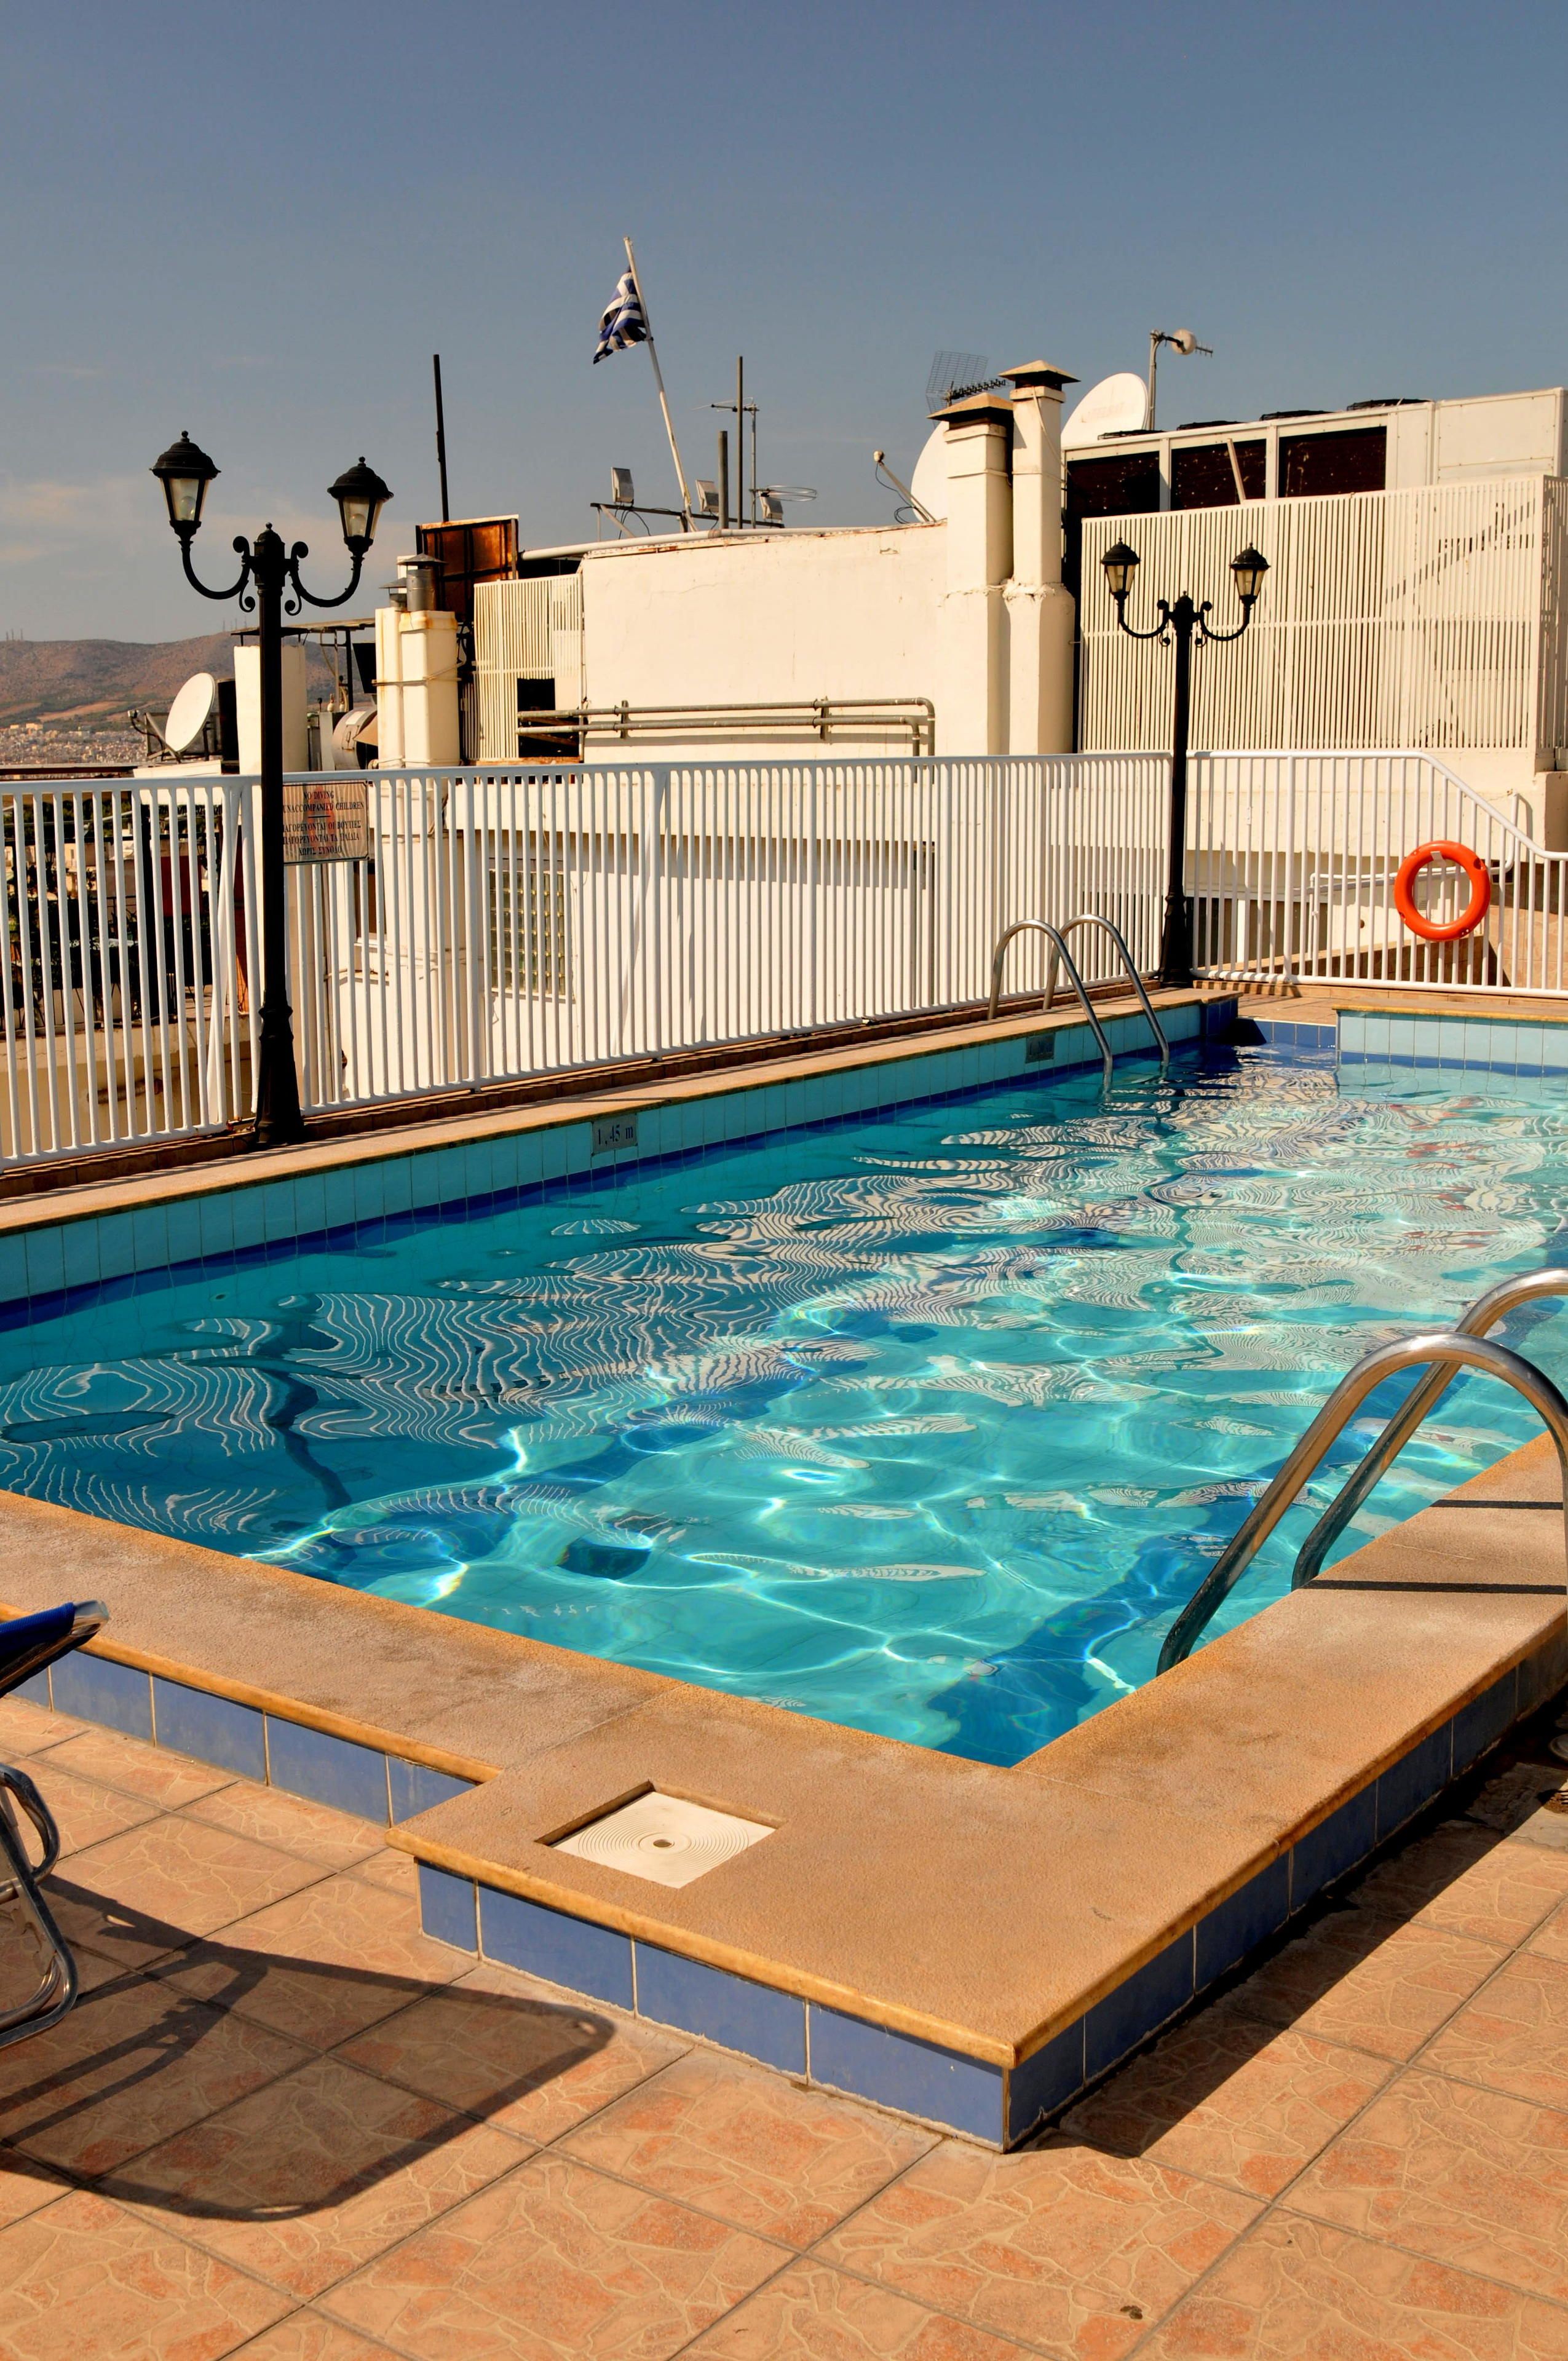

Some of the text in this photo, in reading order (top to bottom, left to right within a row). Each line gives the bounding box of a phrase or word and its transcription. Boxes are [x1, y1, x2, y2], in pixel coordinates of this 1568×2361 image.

[303, 791, 334, 800] NO DIVING
[283, 802, 364, 813] UNACCOMPANIED CHILDREN
[283, 822, 326, 832] ΑΓΟΡΕΥΟΝΤΑΙ
[283, 834, 328, 845] ΠΑΓΟΡΕΥΟΝΤΑΙ
[598, 1124, 633, 1145] 1.45 m
